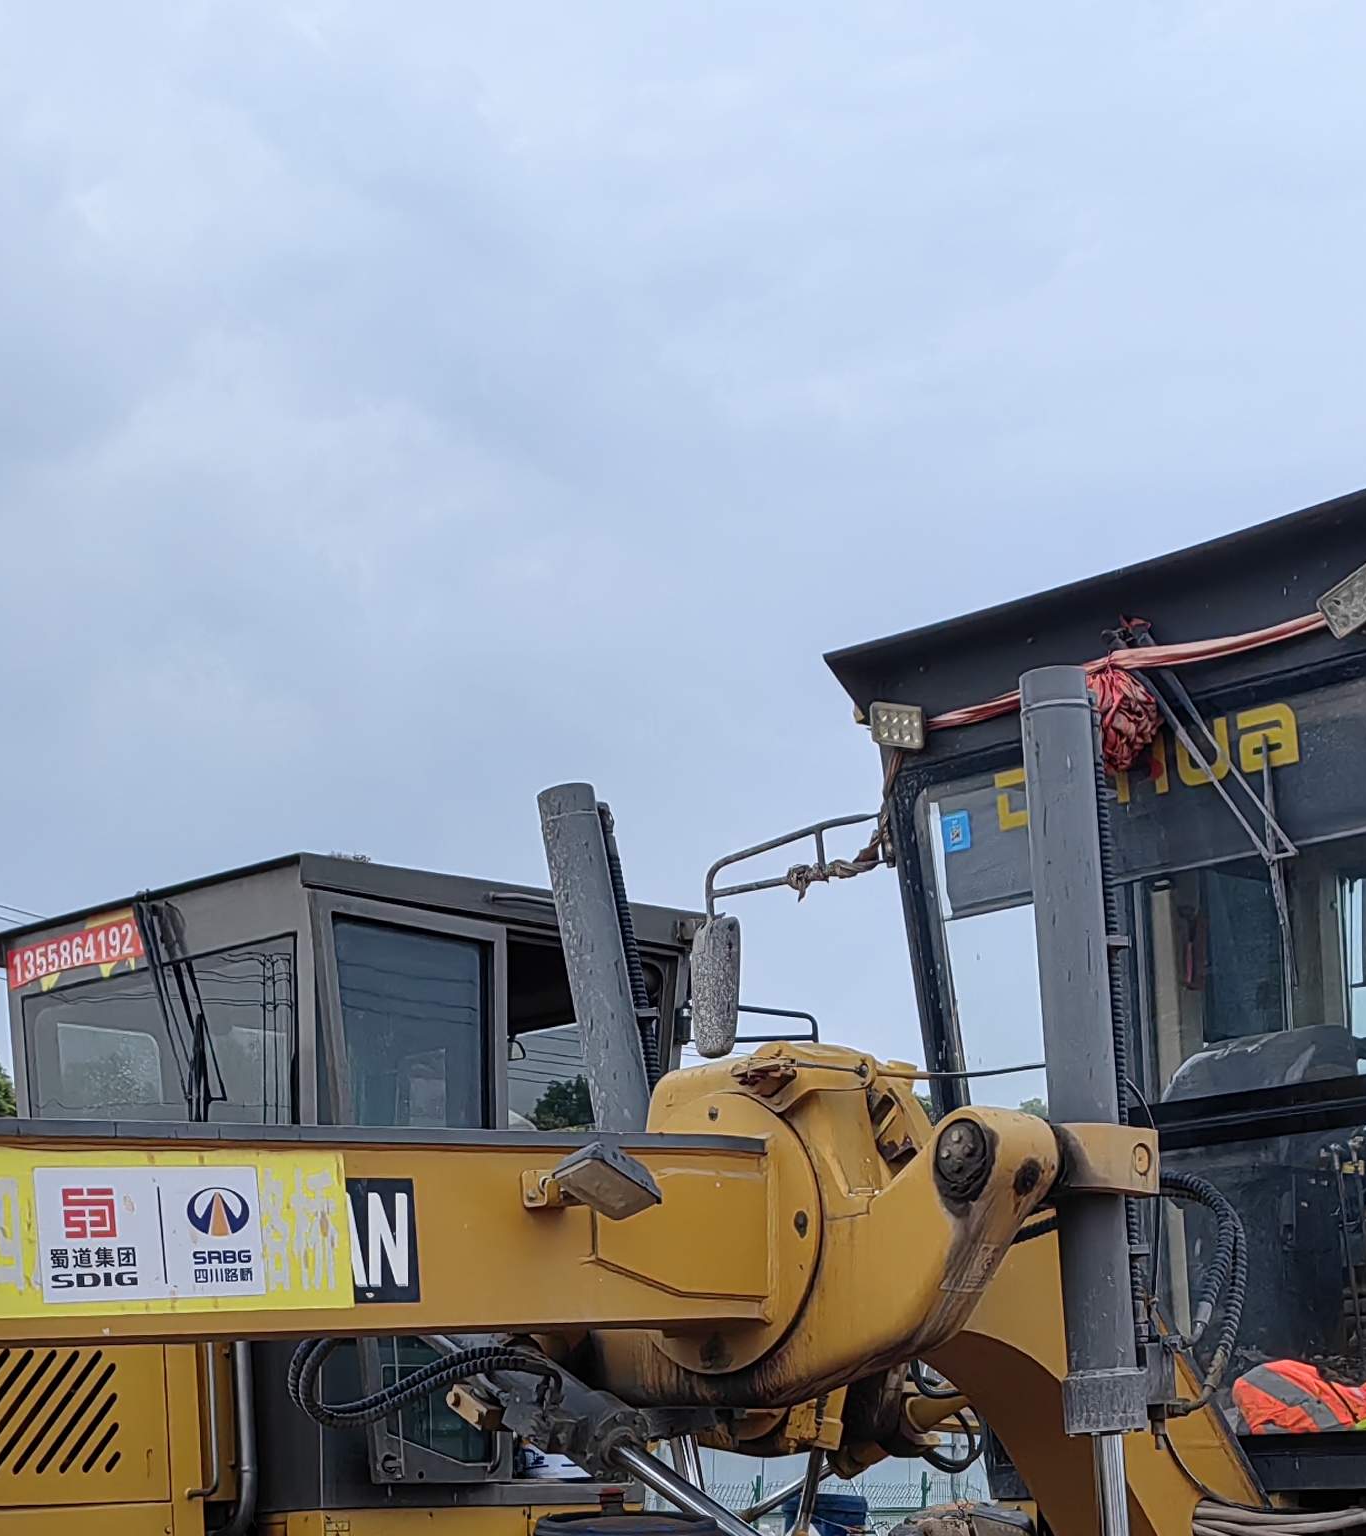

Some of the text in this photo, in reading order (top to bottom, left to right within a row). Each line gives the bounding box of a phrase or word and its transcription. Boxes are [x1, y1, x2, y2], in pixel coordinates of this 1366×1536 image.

[13, 922, 143, 983] 1355864192
[50, 1246, 137, 1269] 蜀道集团
[51, 1271, 138, 1289] SDIG
[194, 1267, 253, 1284] 四川路桥
